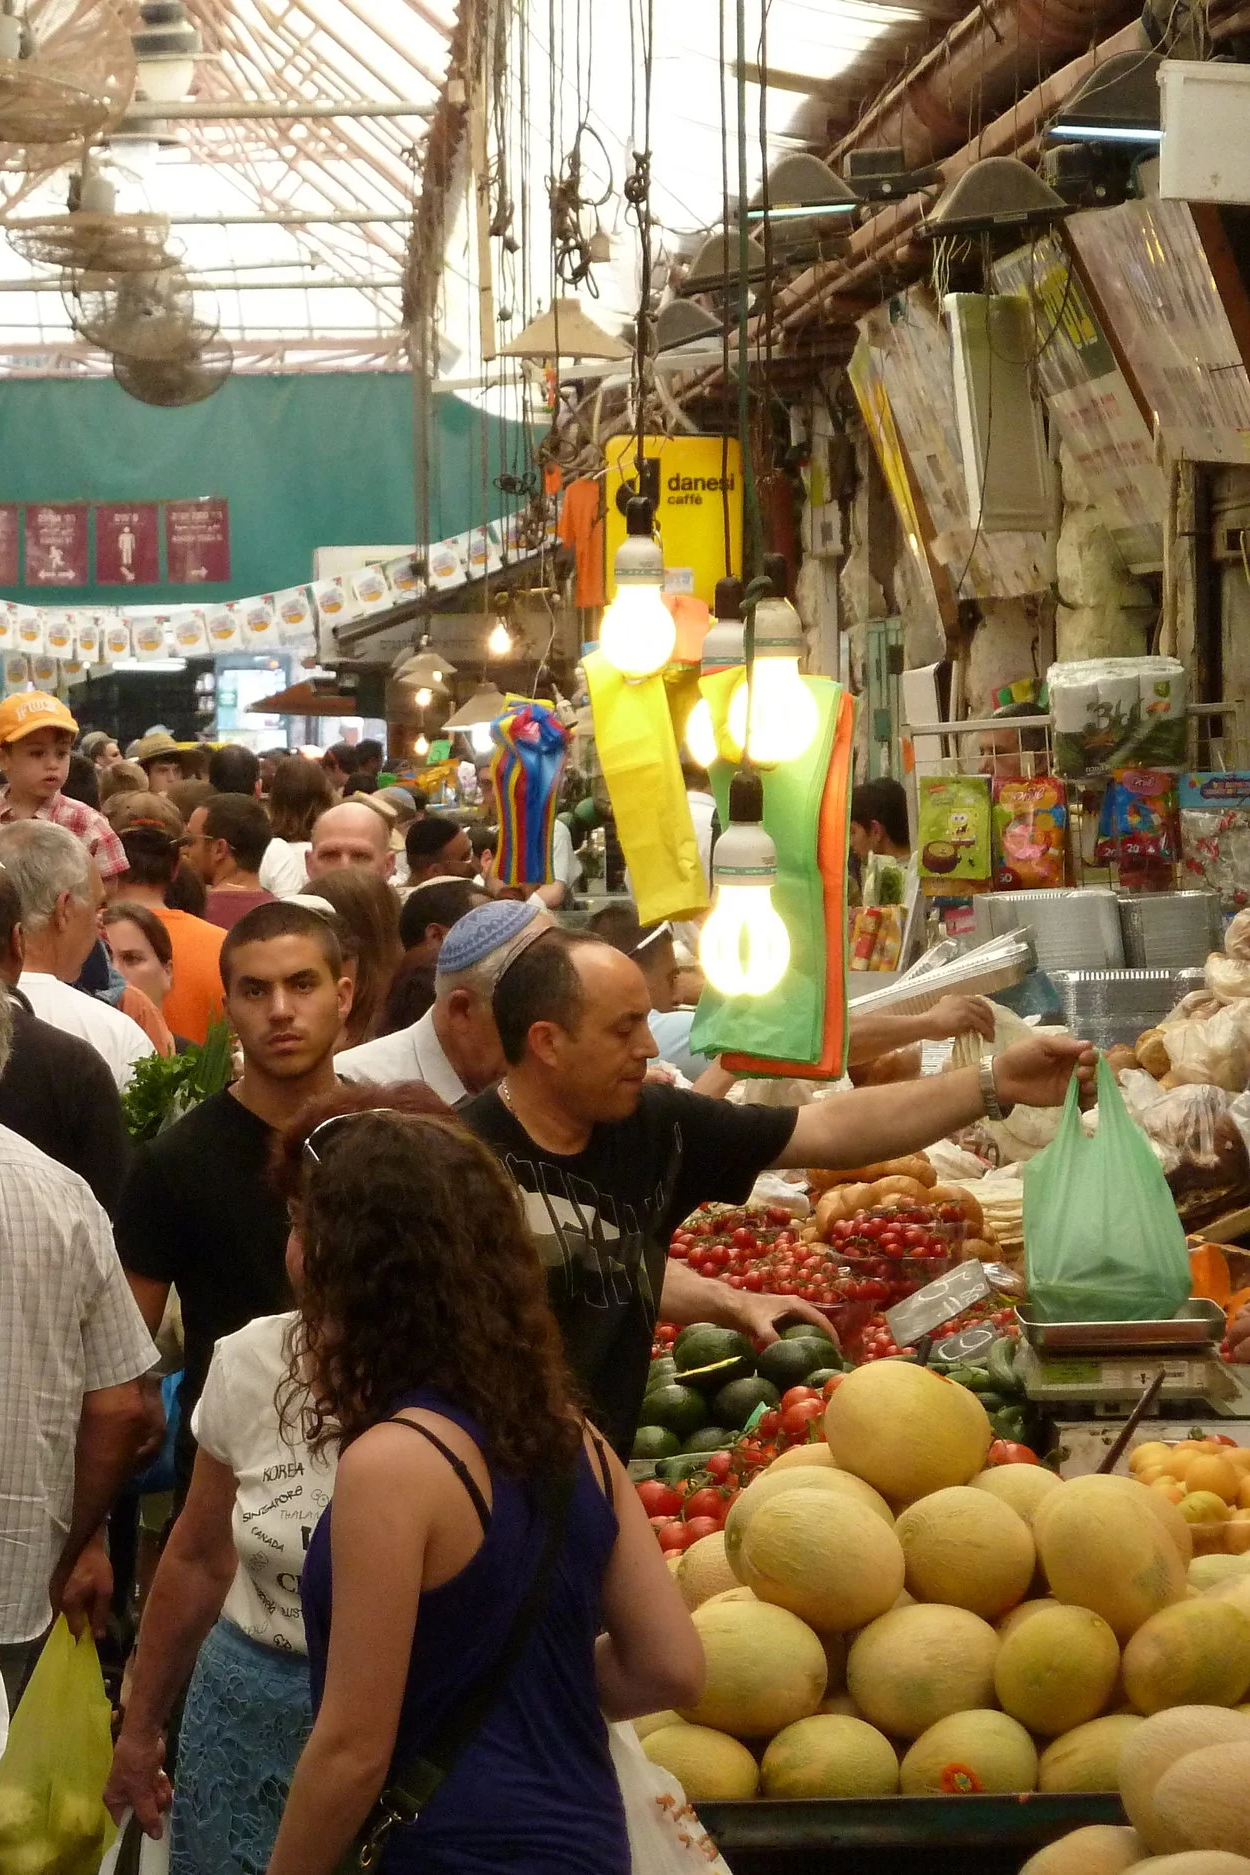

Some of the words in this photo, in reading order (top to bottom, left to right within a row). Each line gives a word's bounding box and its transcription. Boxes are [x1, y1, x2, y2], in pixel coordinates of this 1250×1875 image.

[667, 473, 735, 492] danesi
[667, 494, 703, 505] caffè
[262, 1462, 305, 1482] KOREA
[251, 1526, 285, 1552] CANADA
